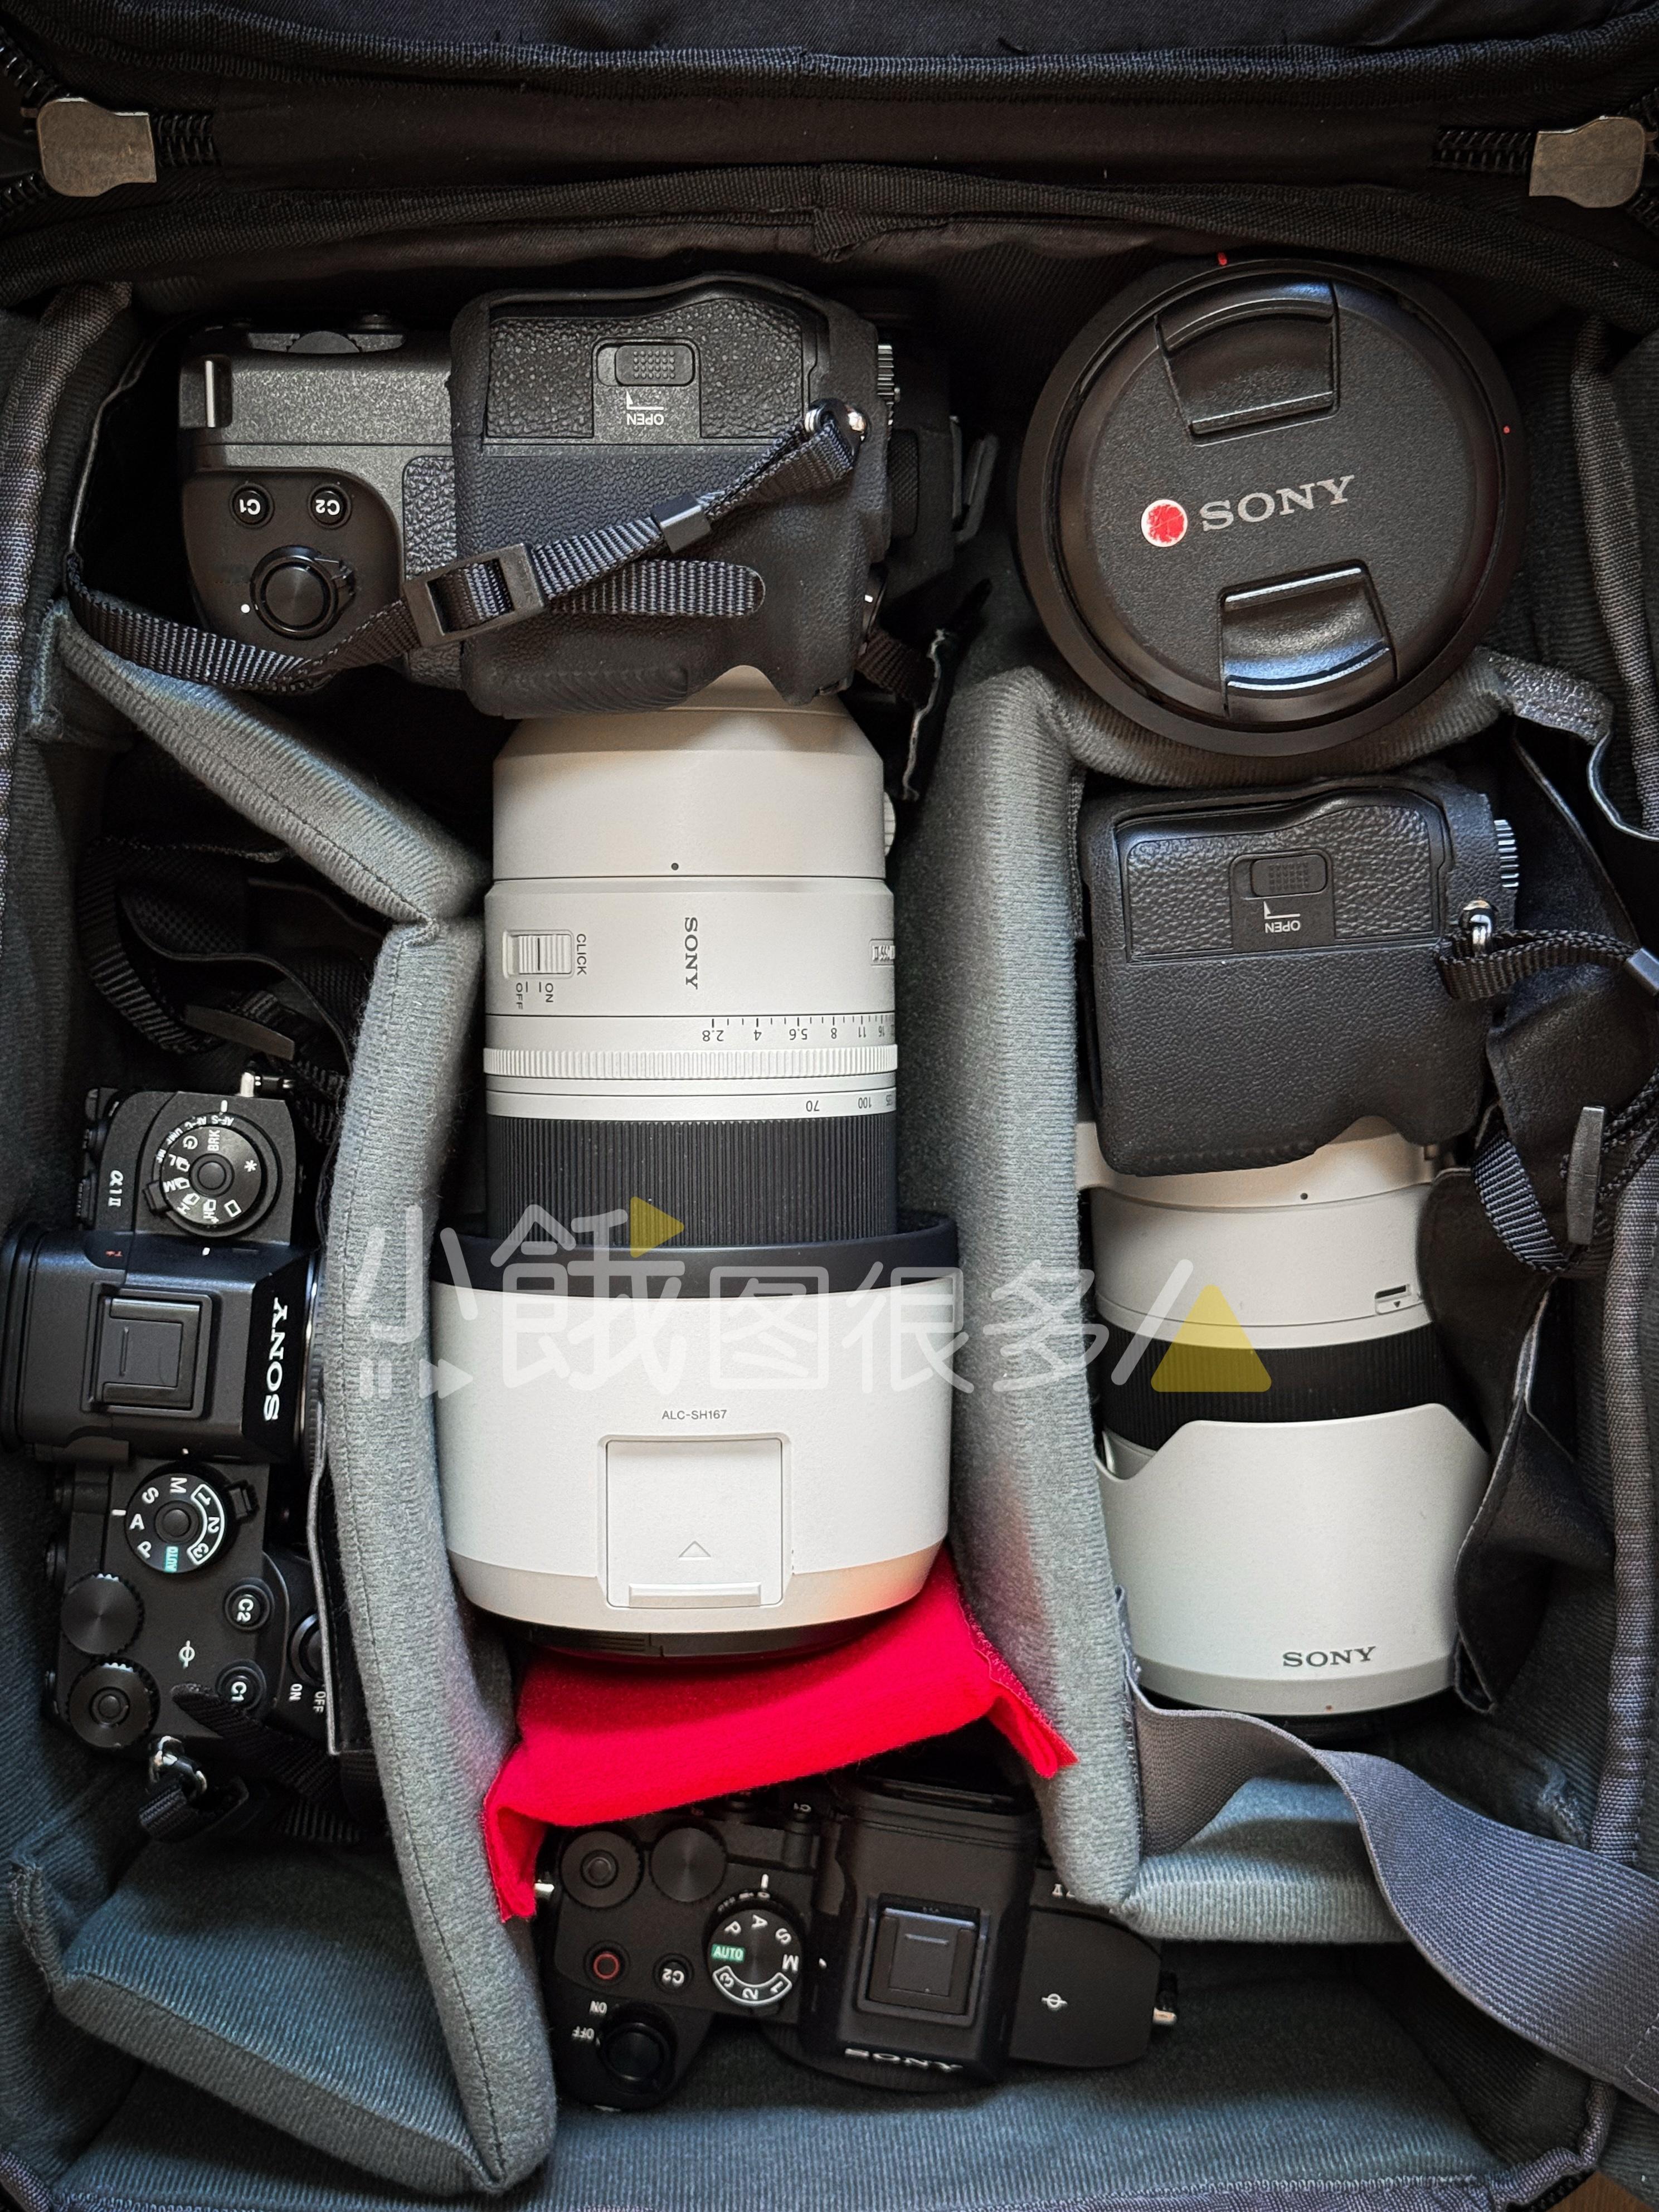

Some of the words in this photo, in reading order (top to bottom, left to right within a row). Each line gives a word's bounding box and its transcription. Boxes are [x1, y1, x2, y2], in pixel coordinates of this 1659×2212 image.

[627, 414, 664, 425] OPEN
[240, 499, 260, 514] C1
[316, 500, 340, 515] C2
[1200, 475, 1354, 531] SONY
[1265, 920, 1300, 933] OPEN
[577, 934, 586, 975] CLICK
[685, 917, 698, 990] SONY
[545, 983, 553, 1002] ON
[702, 1030, 723, 1042] 2.8
[754, 1030, 761, 1041] 4
[790, 1029, 807, 1040] 5.6
[831, 1028, 836, 1039] 8
[859, 1027, 866, 1038] 11
[879, 1026, 885, 1037] 16
[806, 1101, 819, 1112] 70
[858, 1097, 872, 1109] 100
[207, 1130, 220, 1151] BRK
[264, 1297, 288, 1421] SONY
[662, 1409, 727, 1419] ALC-SH167
[171, 1477, 187, 1493] M
[142, 1487, 159, 1503] S
[198, 1493, 211, 1505] 1
[130, 1514, 144, 1529] A
[208, 1517, 220, 1533] 2
[138, 1542, 151, 1558] P
[198, 1543, 210, 1558] 3
[164, 1547, 178, 1572] AUTO
[237, 1599, 253, 1621] C2
[1283, 1646, 1376, 1667] SONY
[232, 1682, 246, 1701] C1
[289, 1684, 302, 1700] ON
[312, 1690, 326, 1713] OFF
[725, 1921, 741, 1933] P
[752, 1915, 767, 1928] A
[776, 1928, 791, 1944] S
[712, 1946, 743, 1961] AUTO
[782, 1955, 799, 1971] M
[663, 1968, 684, 1984] C2
[743, 1988, 758, 2000] 2
[590, 2001, 607, 2014] ON
[572, 2026, 594, 2040] OFF
